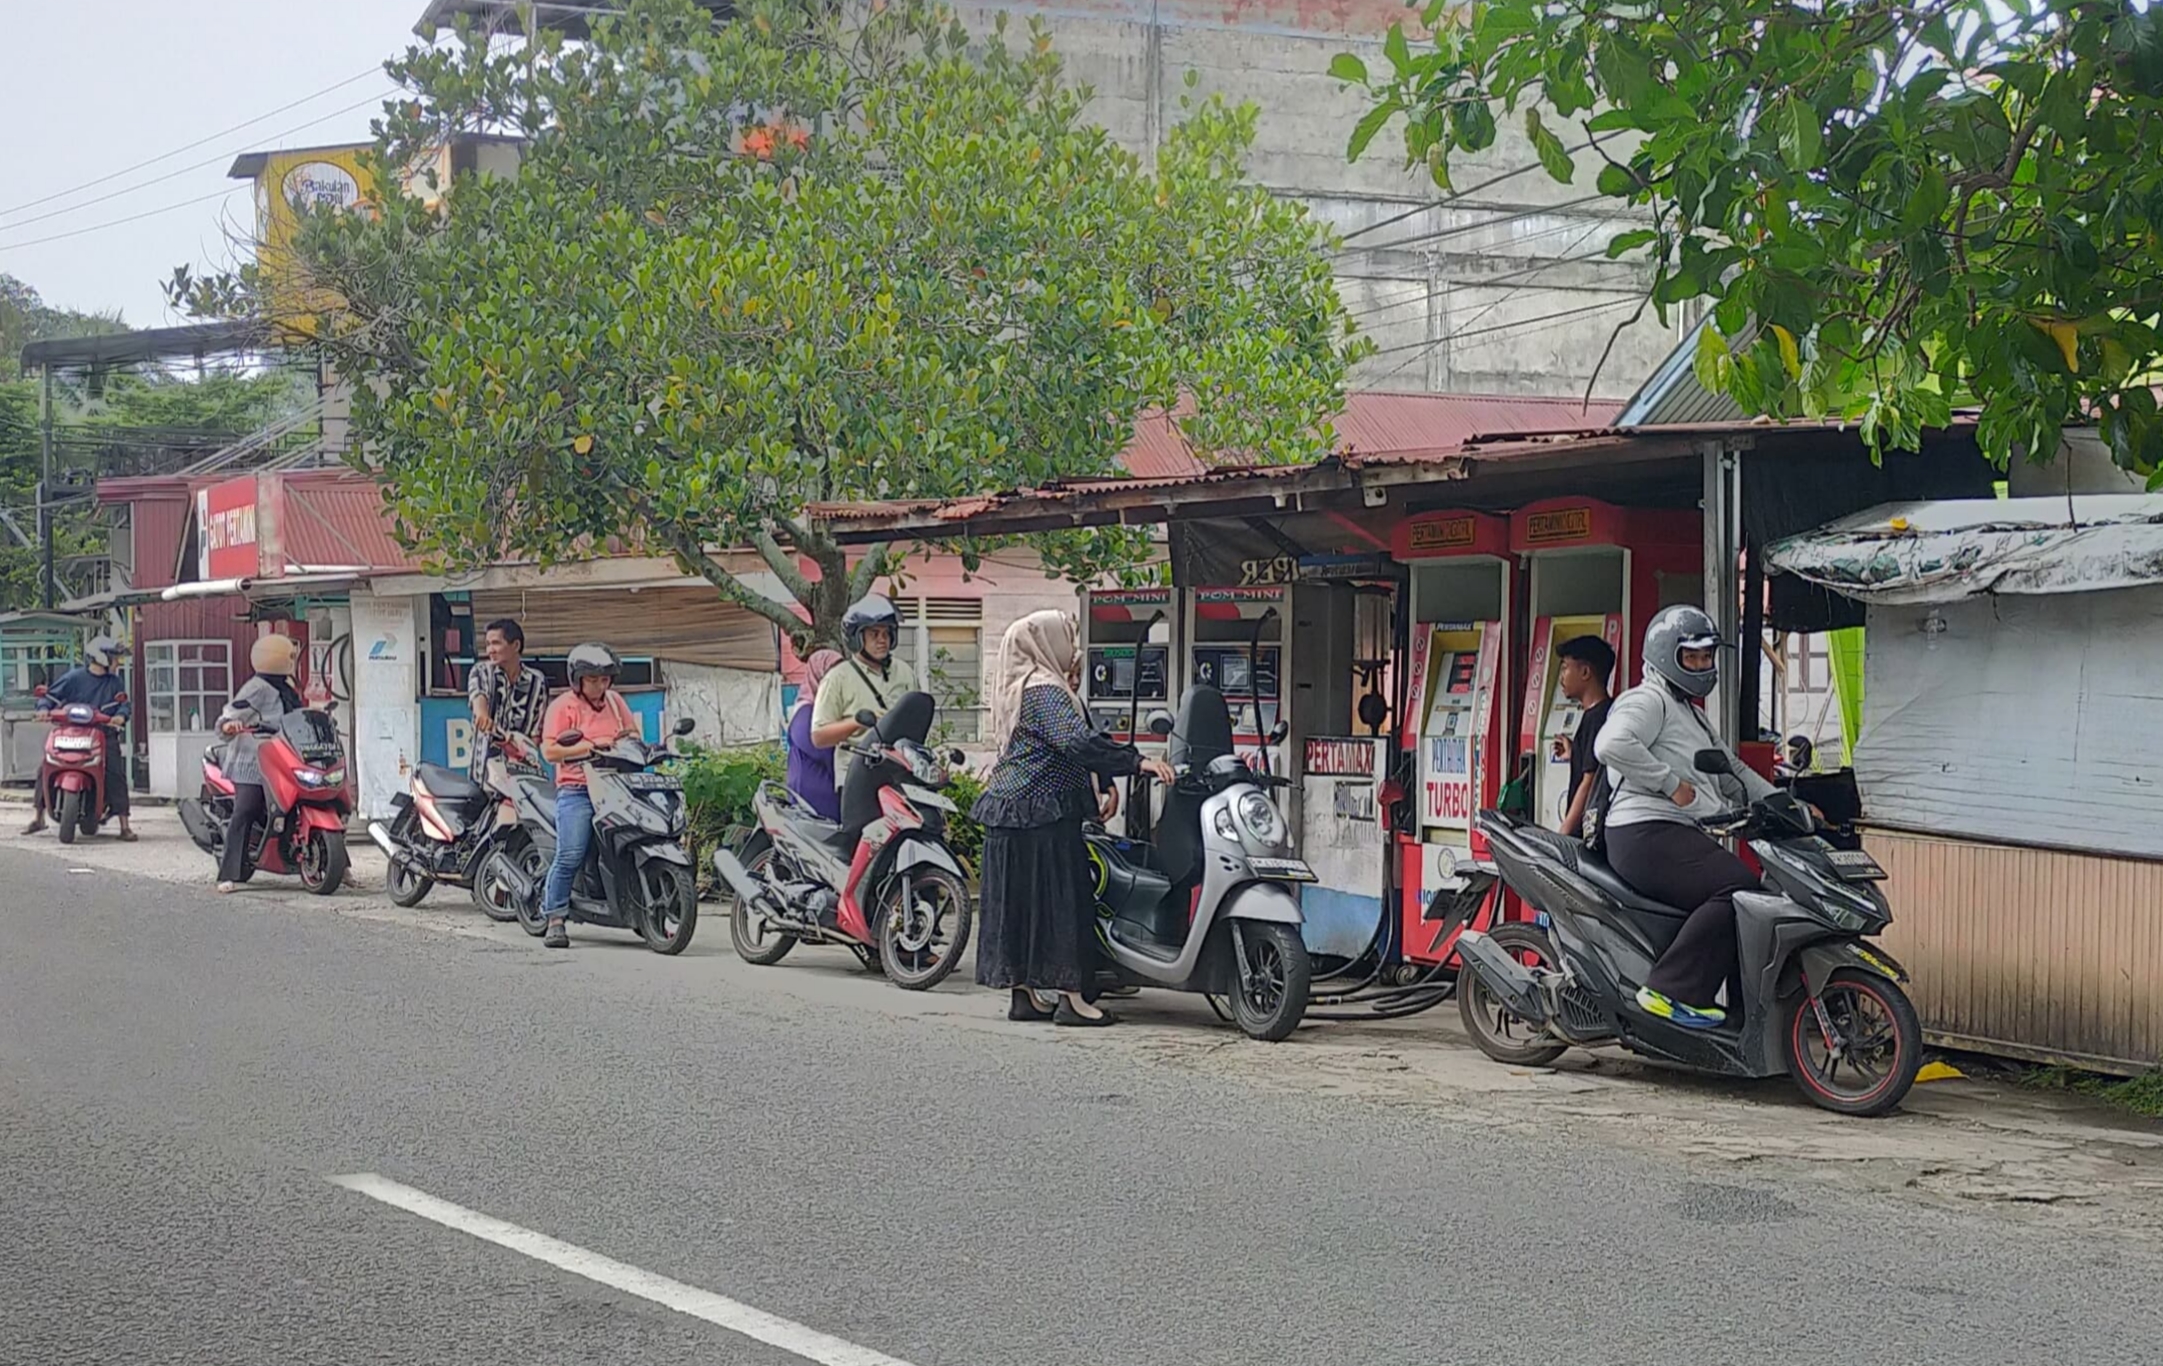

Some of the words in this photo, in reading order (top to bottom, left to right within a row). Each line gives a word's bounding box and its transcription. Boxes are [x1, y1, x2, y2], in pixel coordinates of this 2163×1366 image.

[1092, 594, 1126, 604] POM
[1133, 591, 1168, 602] MINI
[1199, 591, 1236, 600] POM
[1243, 589, 1281, 599] MINI
[1306, 740, 1373, 773] PERTAMAX
[1431, 738, 1467, 774] PERTAMAX
[1426, 781, 1468, 819] TURBO
